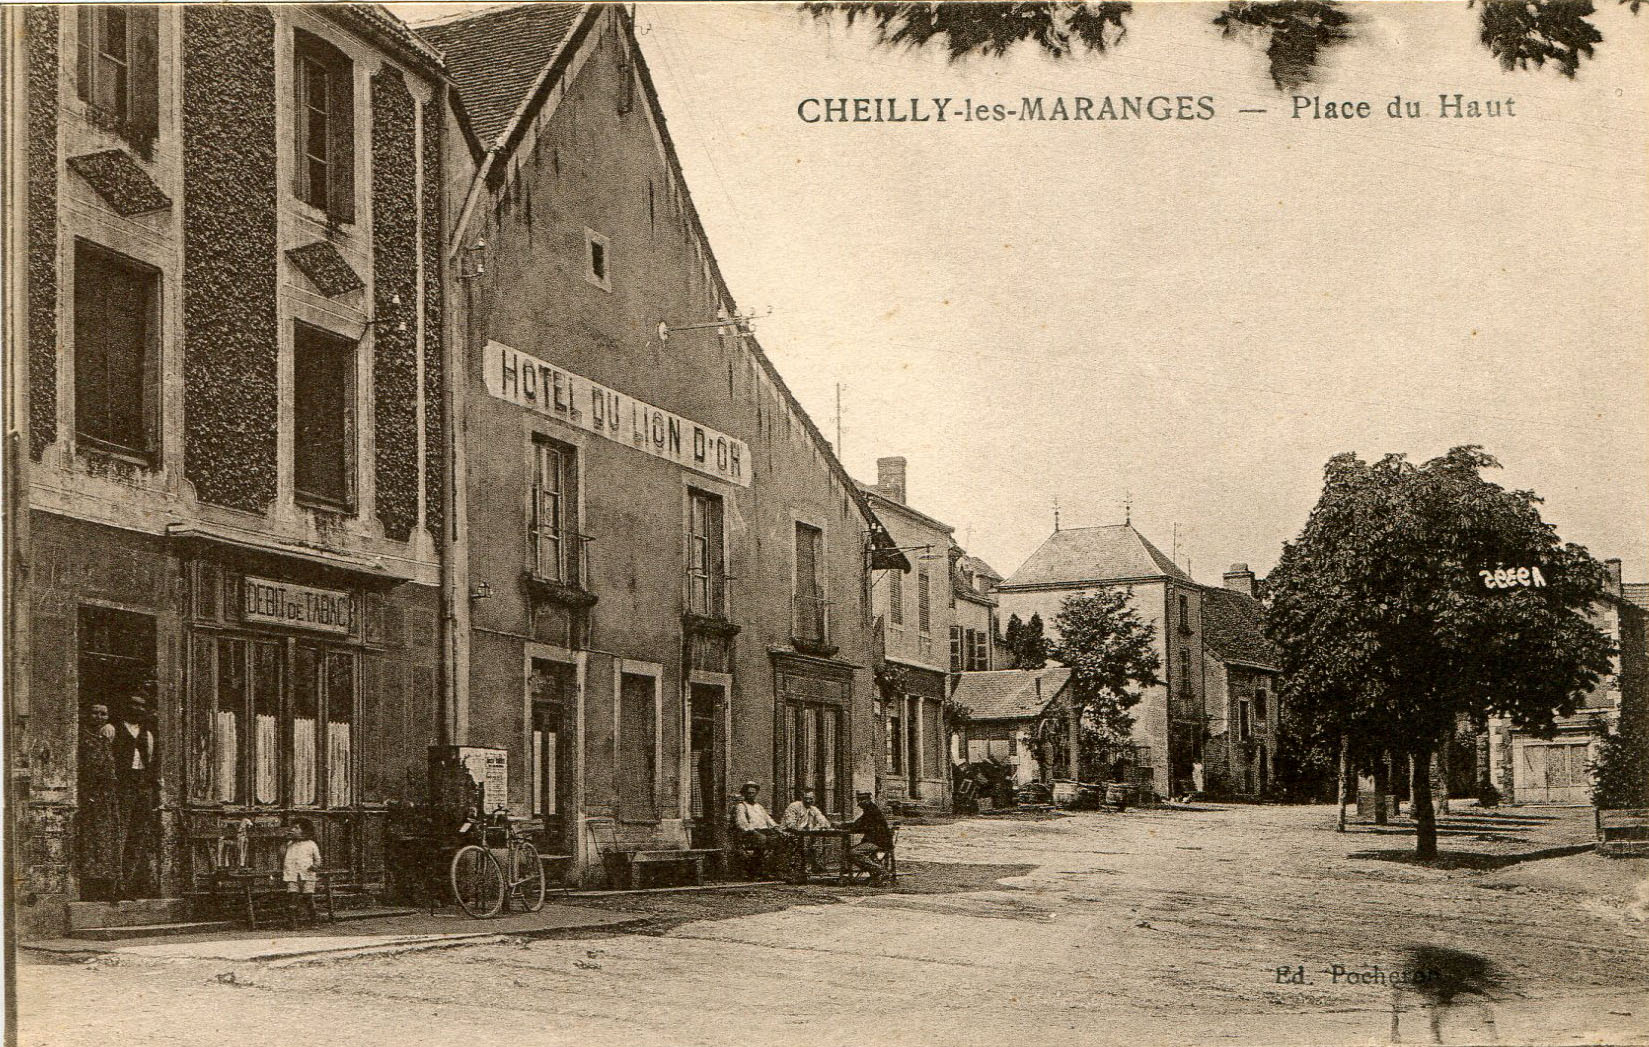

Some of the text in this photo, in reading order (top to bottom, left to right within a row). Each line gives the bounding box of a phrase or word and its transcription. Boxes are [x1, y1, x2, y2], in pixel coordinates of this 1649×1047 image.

[592, 386, 619, 432] DU
[632, 402, 681, 454] LION
[287, 602, 303, 621] DE
[305, 592, 346, 626] TABAC
